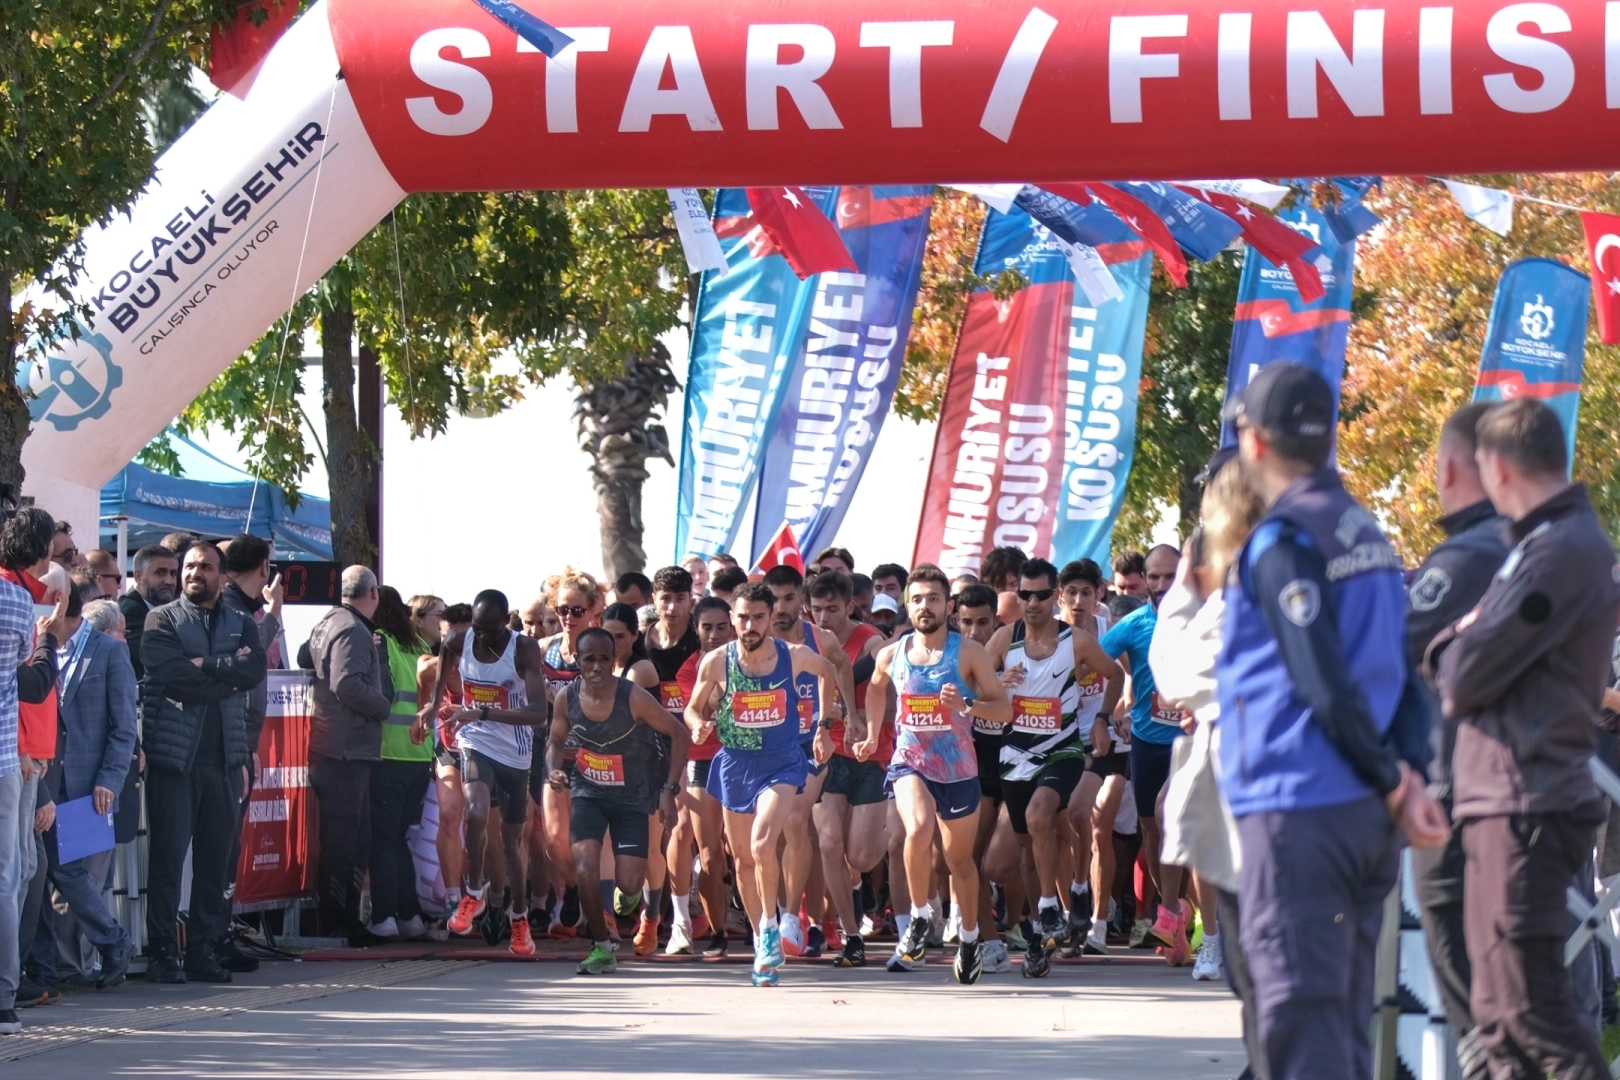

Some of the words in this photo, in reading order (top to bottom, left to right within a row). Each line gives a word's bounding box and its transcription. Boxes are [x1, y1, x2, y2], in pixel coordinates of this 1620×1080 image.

[91, 189, 216, 312] KOCAELİ
[108, 121, 326, 334] BÜYÜKŞEHİR
[139, 283, 217, 355] ÇALIŞINCA
[217, 219, 280, 280] OLUYOR
[993, 403, 1055, 560] OŞUSU
[739, 708, 780, 722] 41414
[905, 713, 944, 726] 41214
[1015, 713, 1056, 728] 41035
[584, 767, 615, 781] 41151
